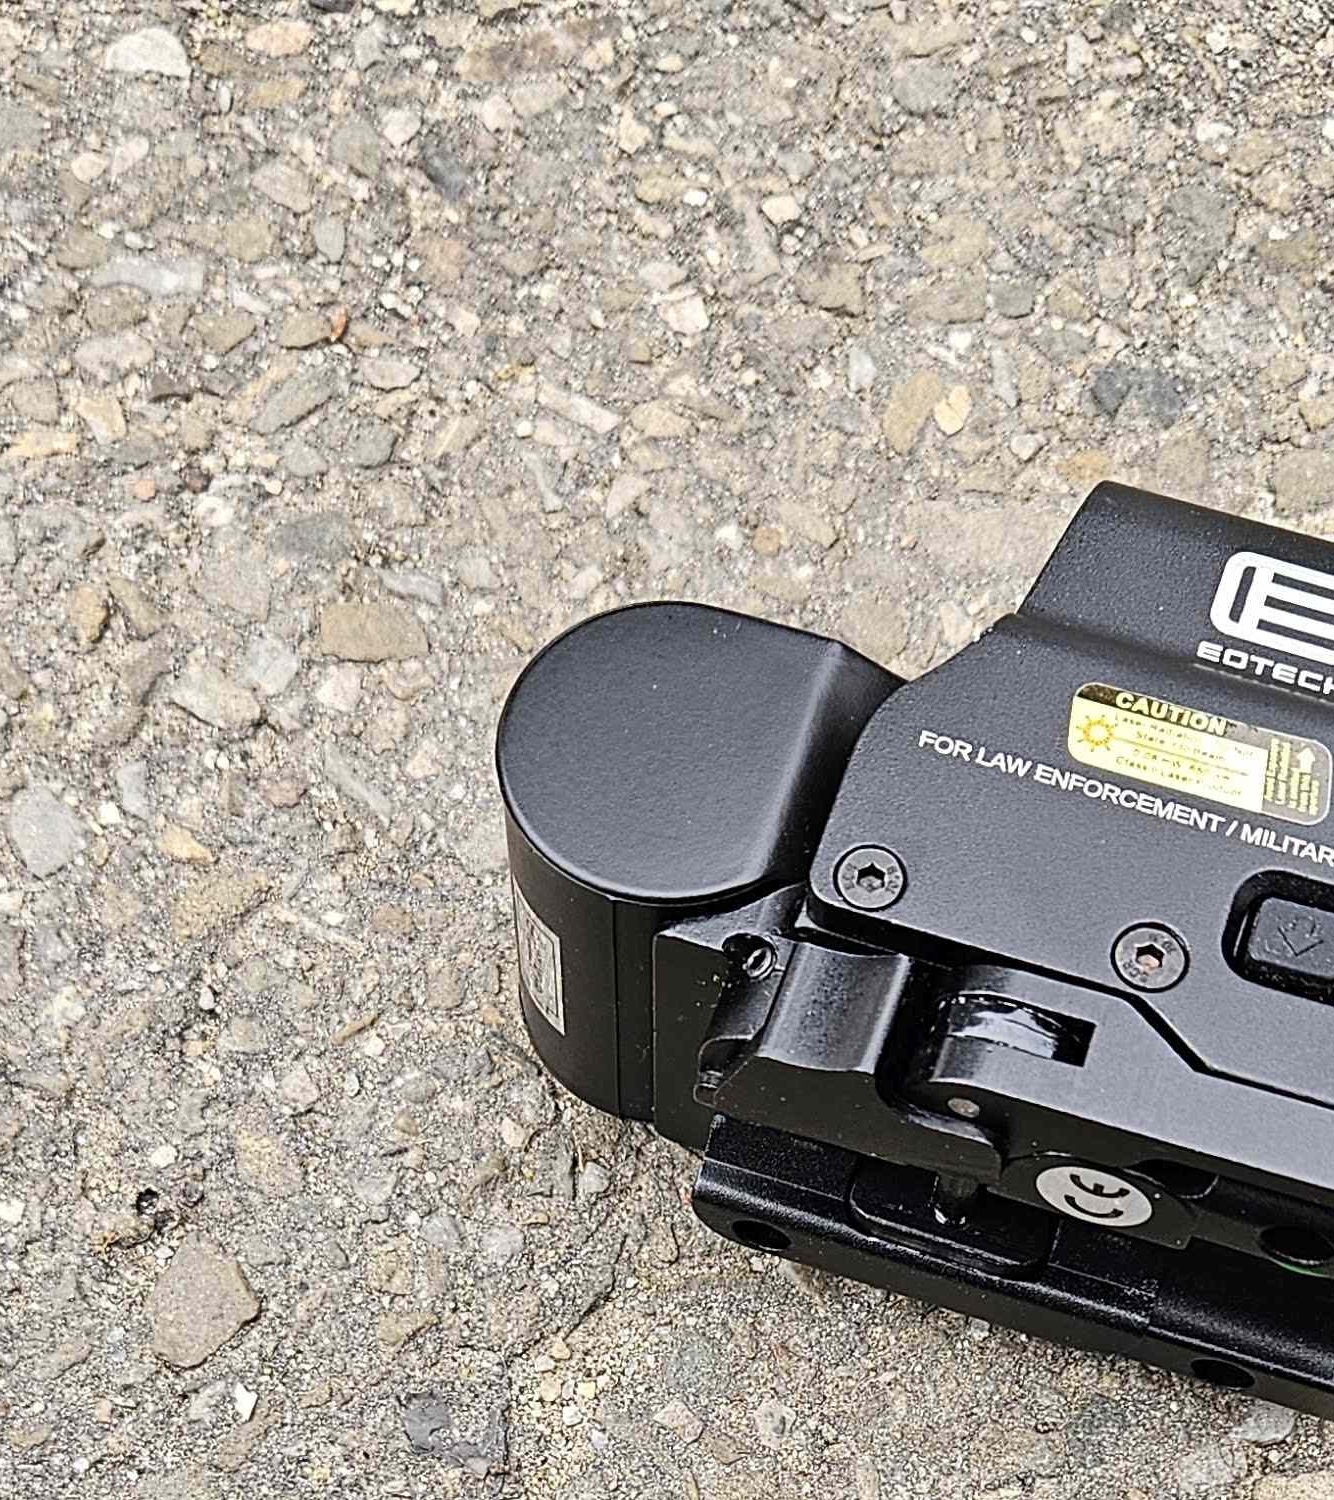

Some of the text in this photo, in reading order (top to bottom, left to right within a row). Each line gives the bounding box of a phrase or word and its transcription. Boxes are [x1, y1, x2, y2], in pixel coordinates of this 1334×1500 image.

[1116, 692, 1227, 737] CAUTION
[918, 730, 973, 762] FOR
[975, 747, 1032, 778] LAW
[1033, 763, 1226, 833] ENFORCEMENT
